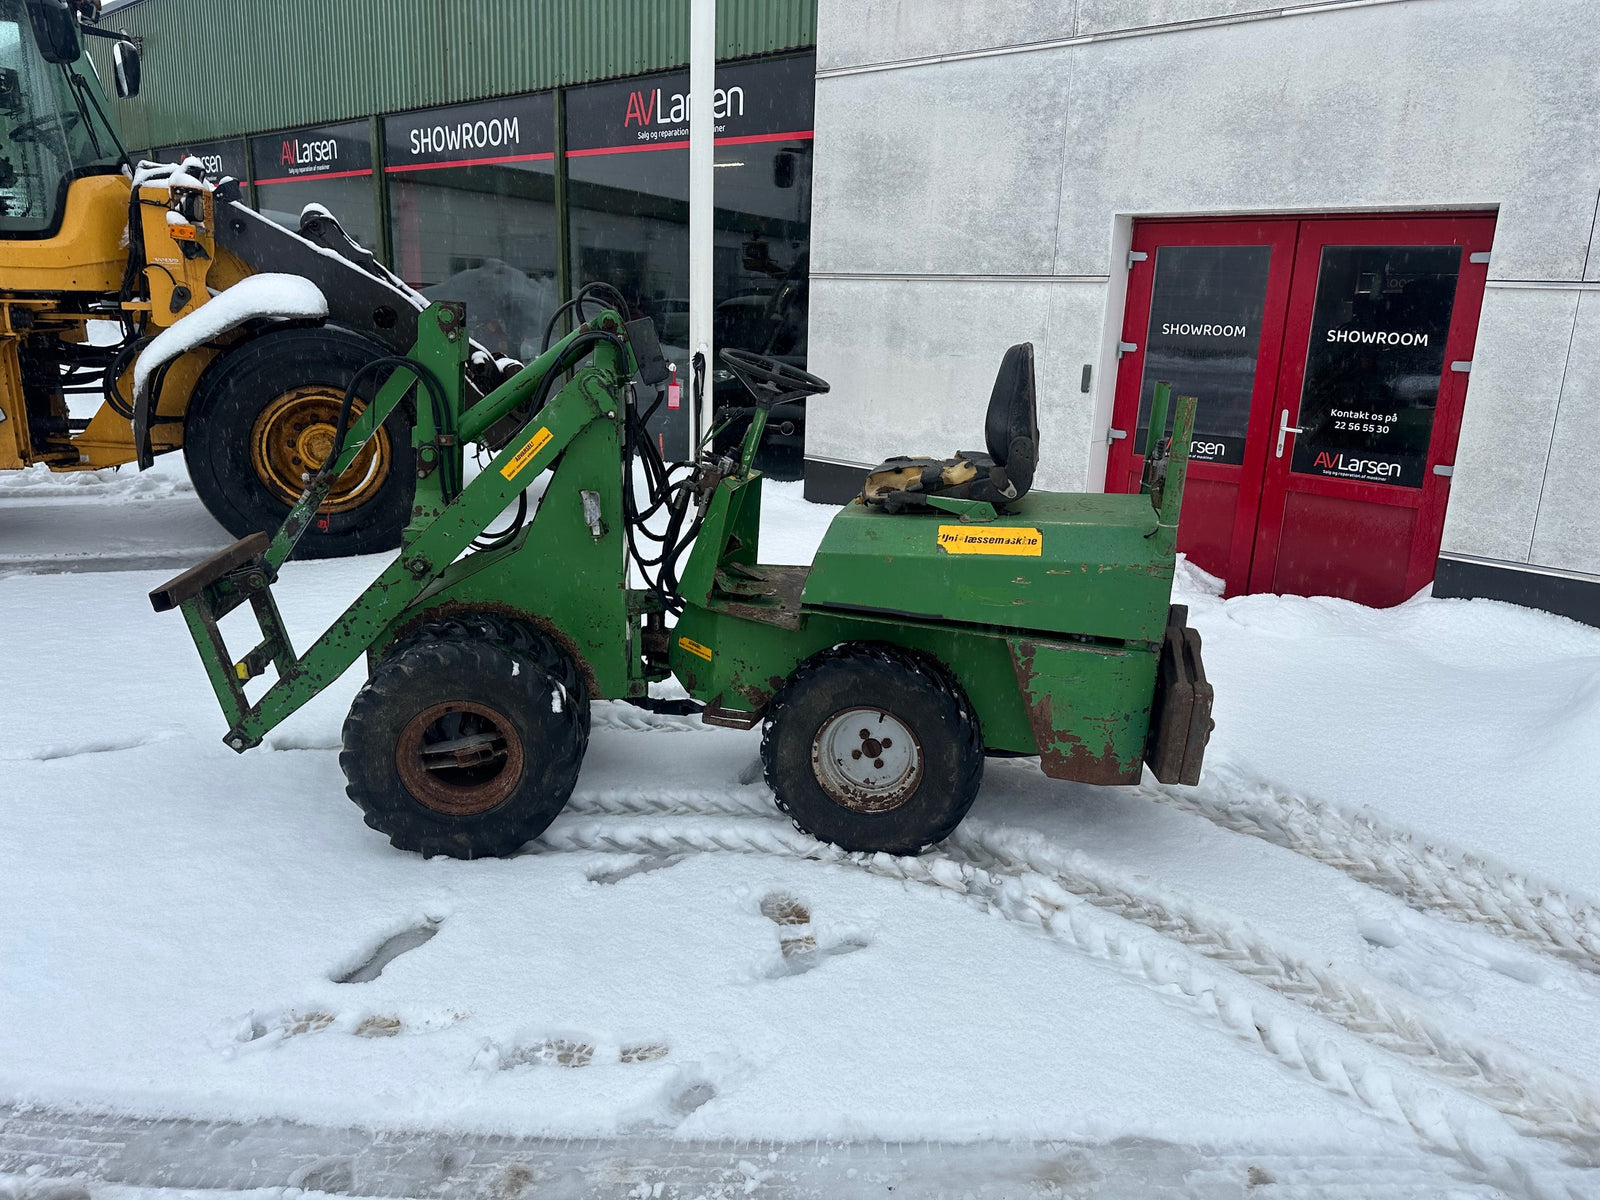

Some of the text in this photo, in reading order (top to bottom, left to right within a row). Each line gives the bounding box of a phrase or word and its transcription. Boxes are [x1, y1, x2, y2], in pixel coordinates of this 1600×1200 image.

[624, 86, 744, 128] AVLaren
[410, 116, 520, 155] SHOWROOM
[637, 127, 689, 141] Salg og reparation
[281, 139, 338, 166] AVLarsen
[1161, 323, 1246, 338] SHOWROOM
[1326, 329, 1429, 347] SHOWROOM
[1330, 408, 1398, 423] Kontakt os på
[1334, 421, 1390, 434] 22 56 55 30
[1313, 451, 1402, 477] AVLarsen
